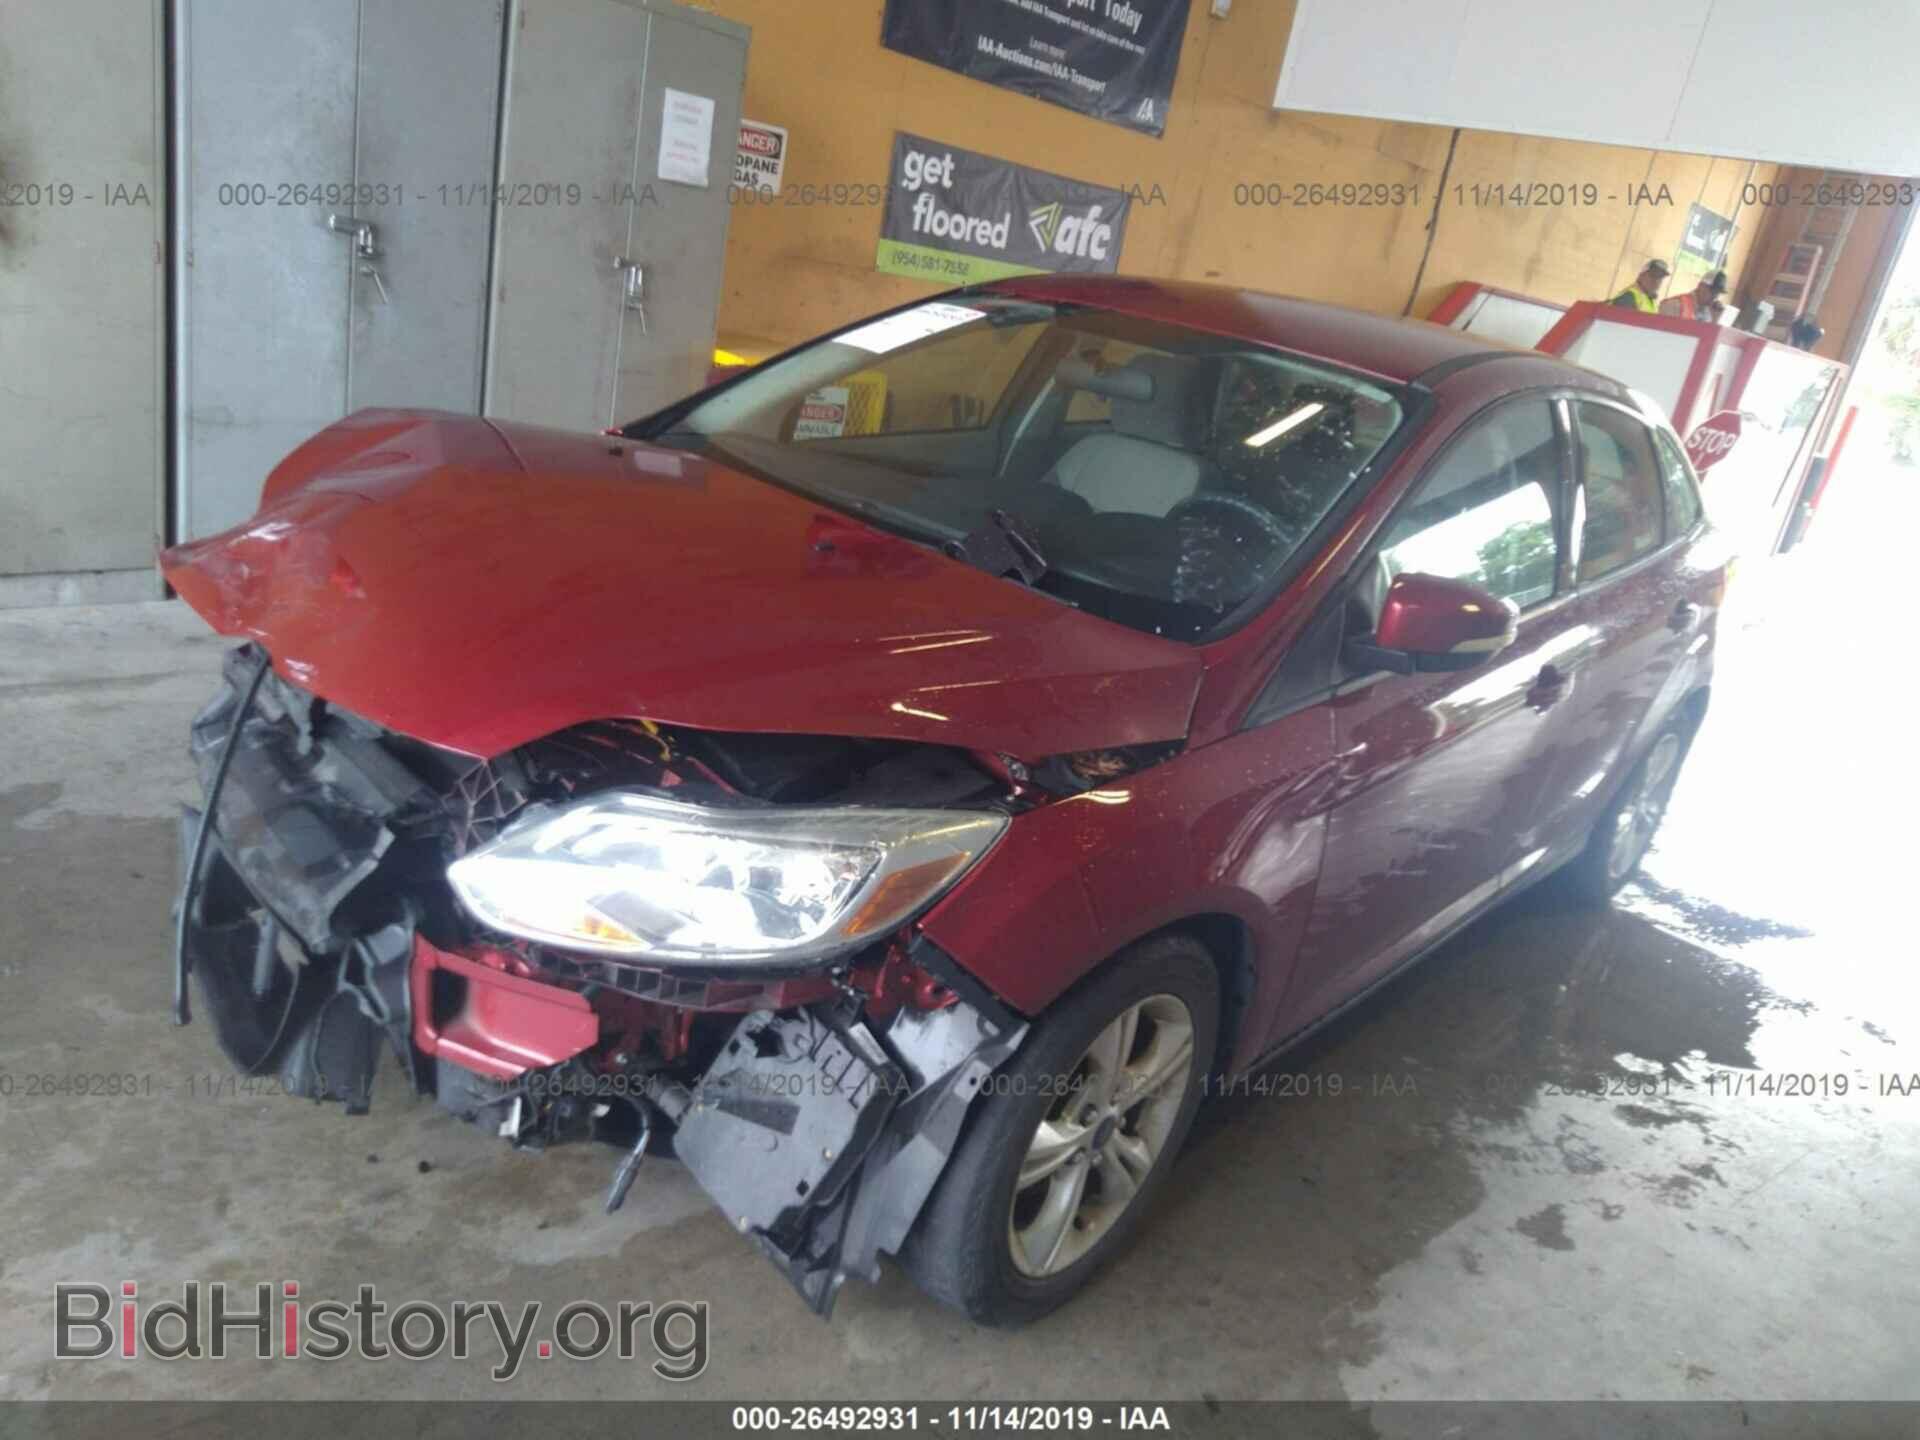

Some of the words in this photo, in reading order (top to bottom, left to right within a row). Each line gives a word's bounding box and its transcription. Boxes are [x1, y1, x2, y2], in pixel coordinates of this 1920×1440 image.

[1104, 0, 1143, 35] Today
[901, 150, 955, 190] get
[912, 192, 1011, 250] floored
[1054, 205, 1112, 260] afc
[1687, 427, 1737, 456] STOP
